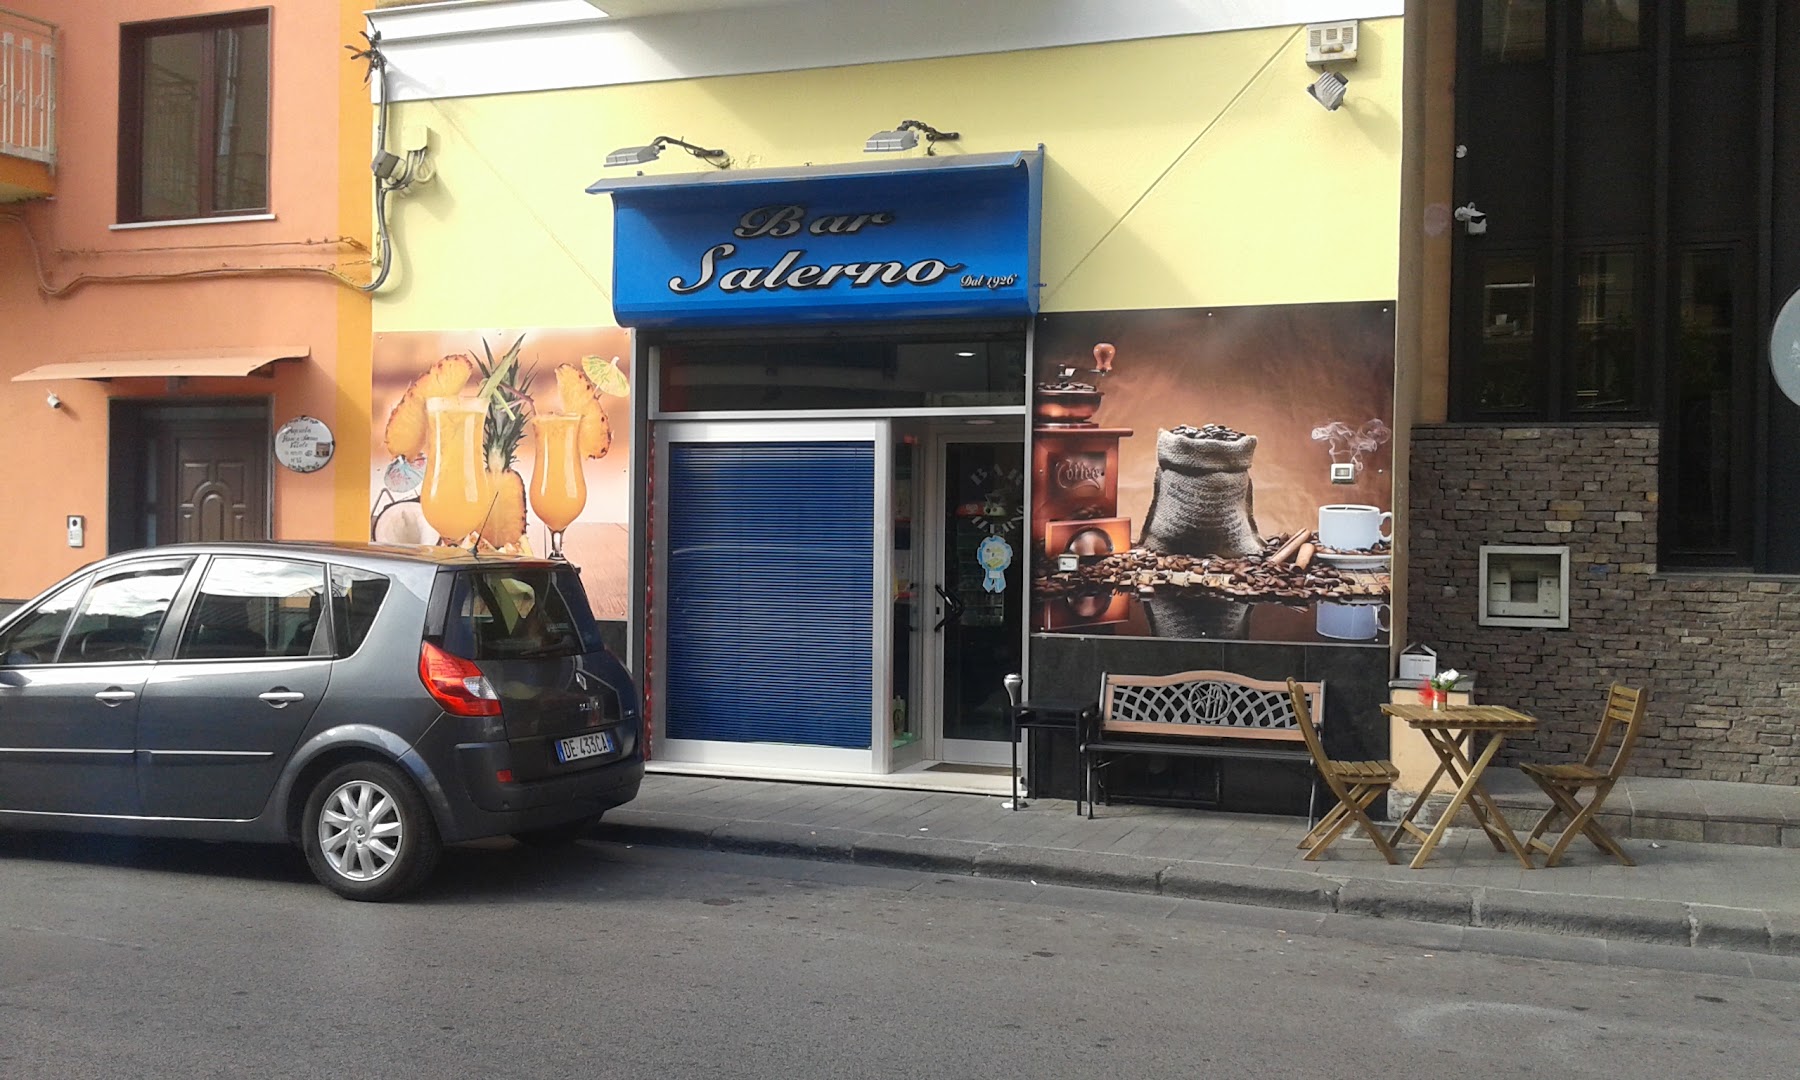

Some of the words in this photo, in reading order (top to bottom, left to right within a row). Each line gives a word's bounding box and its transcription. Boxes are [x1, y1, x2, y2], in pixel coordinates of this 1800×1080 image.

[733, 204, 894, 239] Bar
[667, 241, 967, 294] Salerno
[960, 274, 984, 288] Dal
[1056, 457, 1102, 489] Coffee
